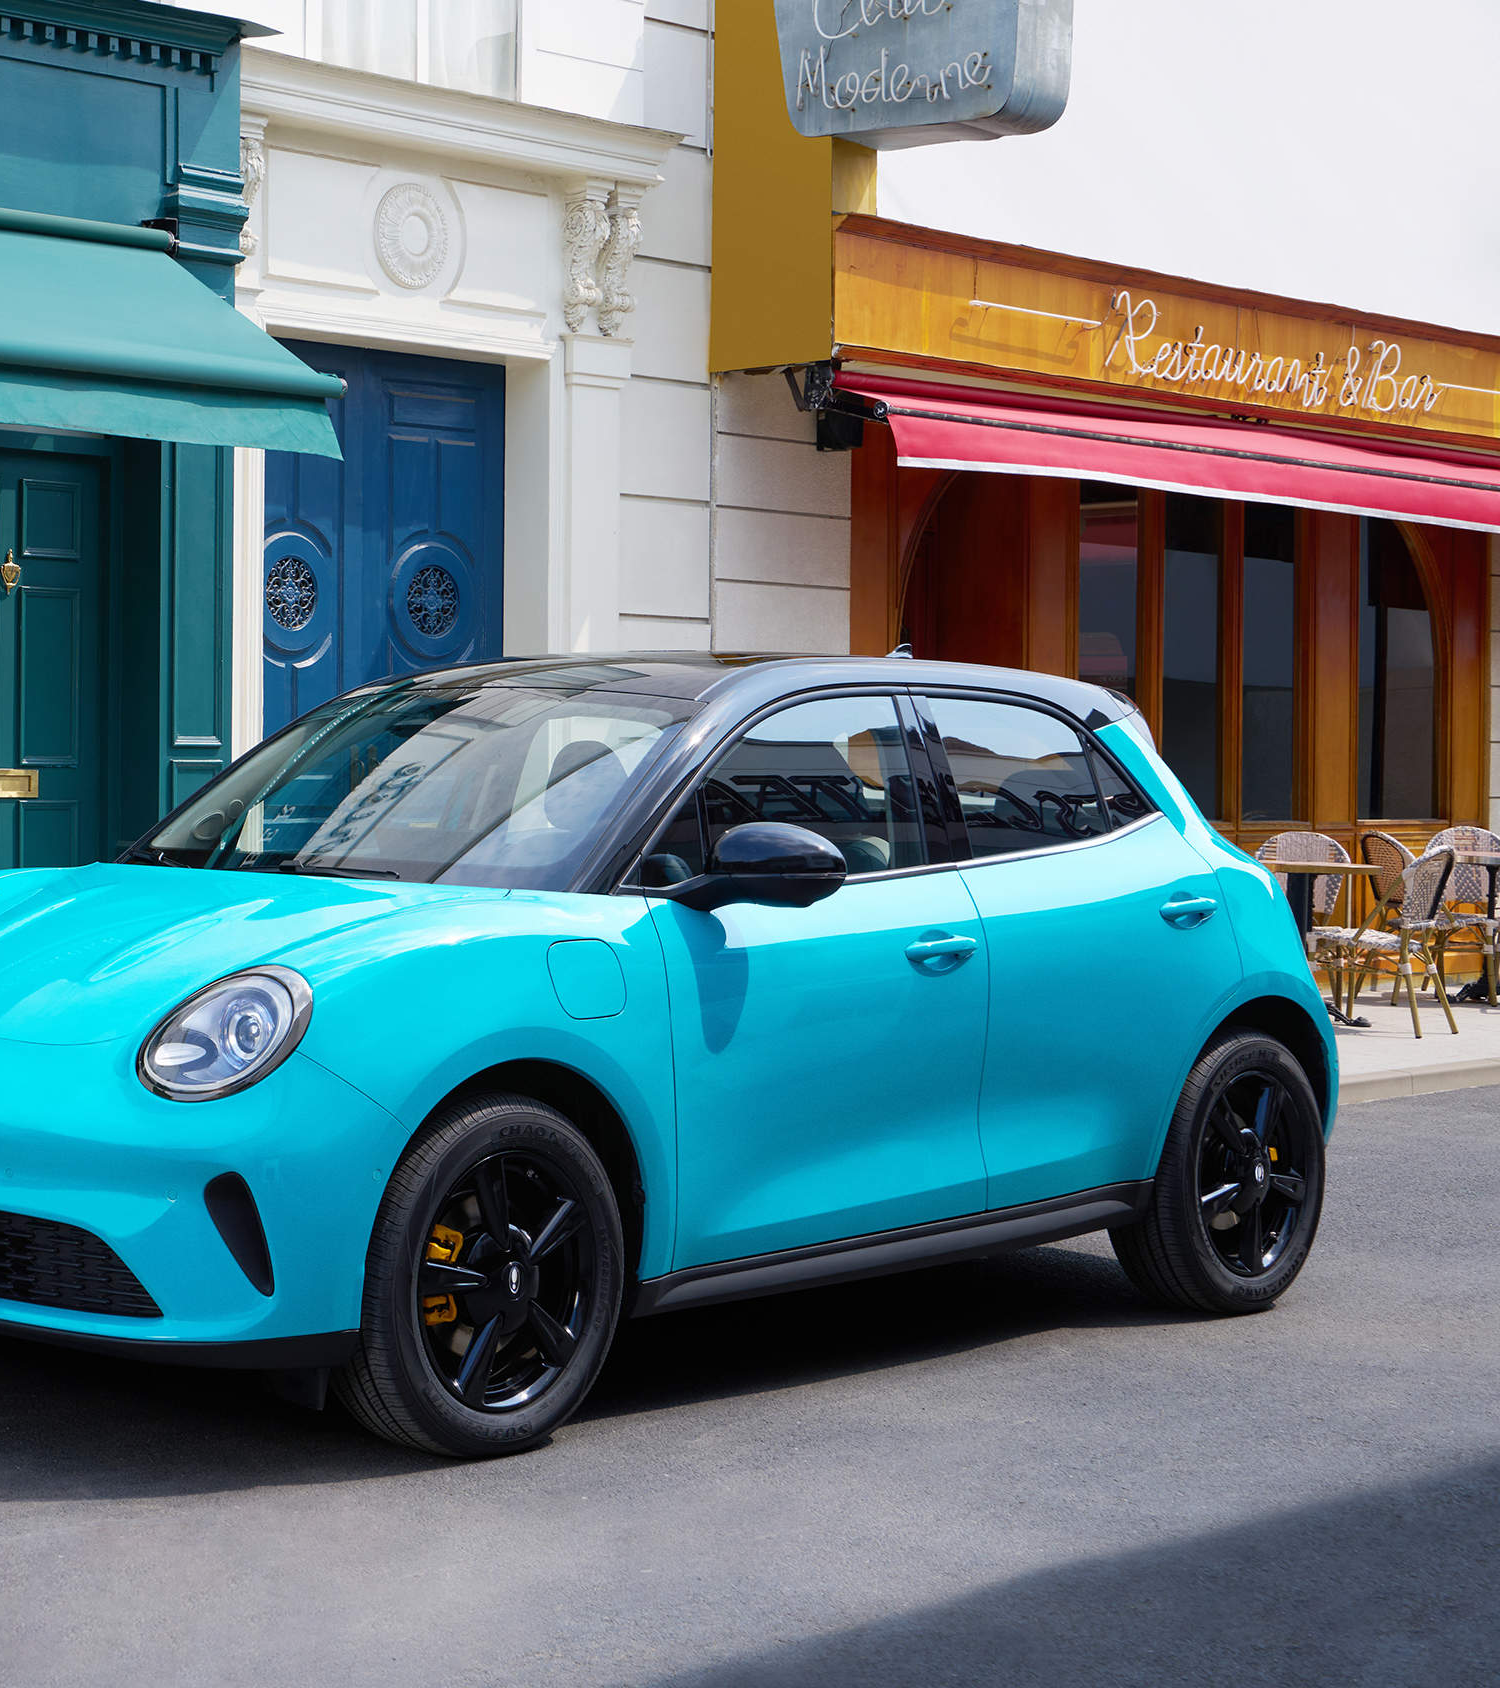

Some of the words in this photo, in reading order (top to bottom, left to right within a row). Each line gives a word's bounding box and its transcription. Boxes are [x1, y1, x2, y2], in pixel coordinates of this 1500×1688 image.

[796, 45, 993, 110] Moderne
[1105, 291, 1329, 408] Restaurant
[1339, 346, 1363, 407] &
[1362, 341, 1440, 411] Bar
